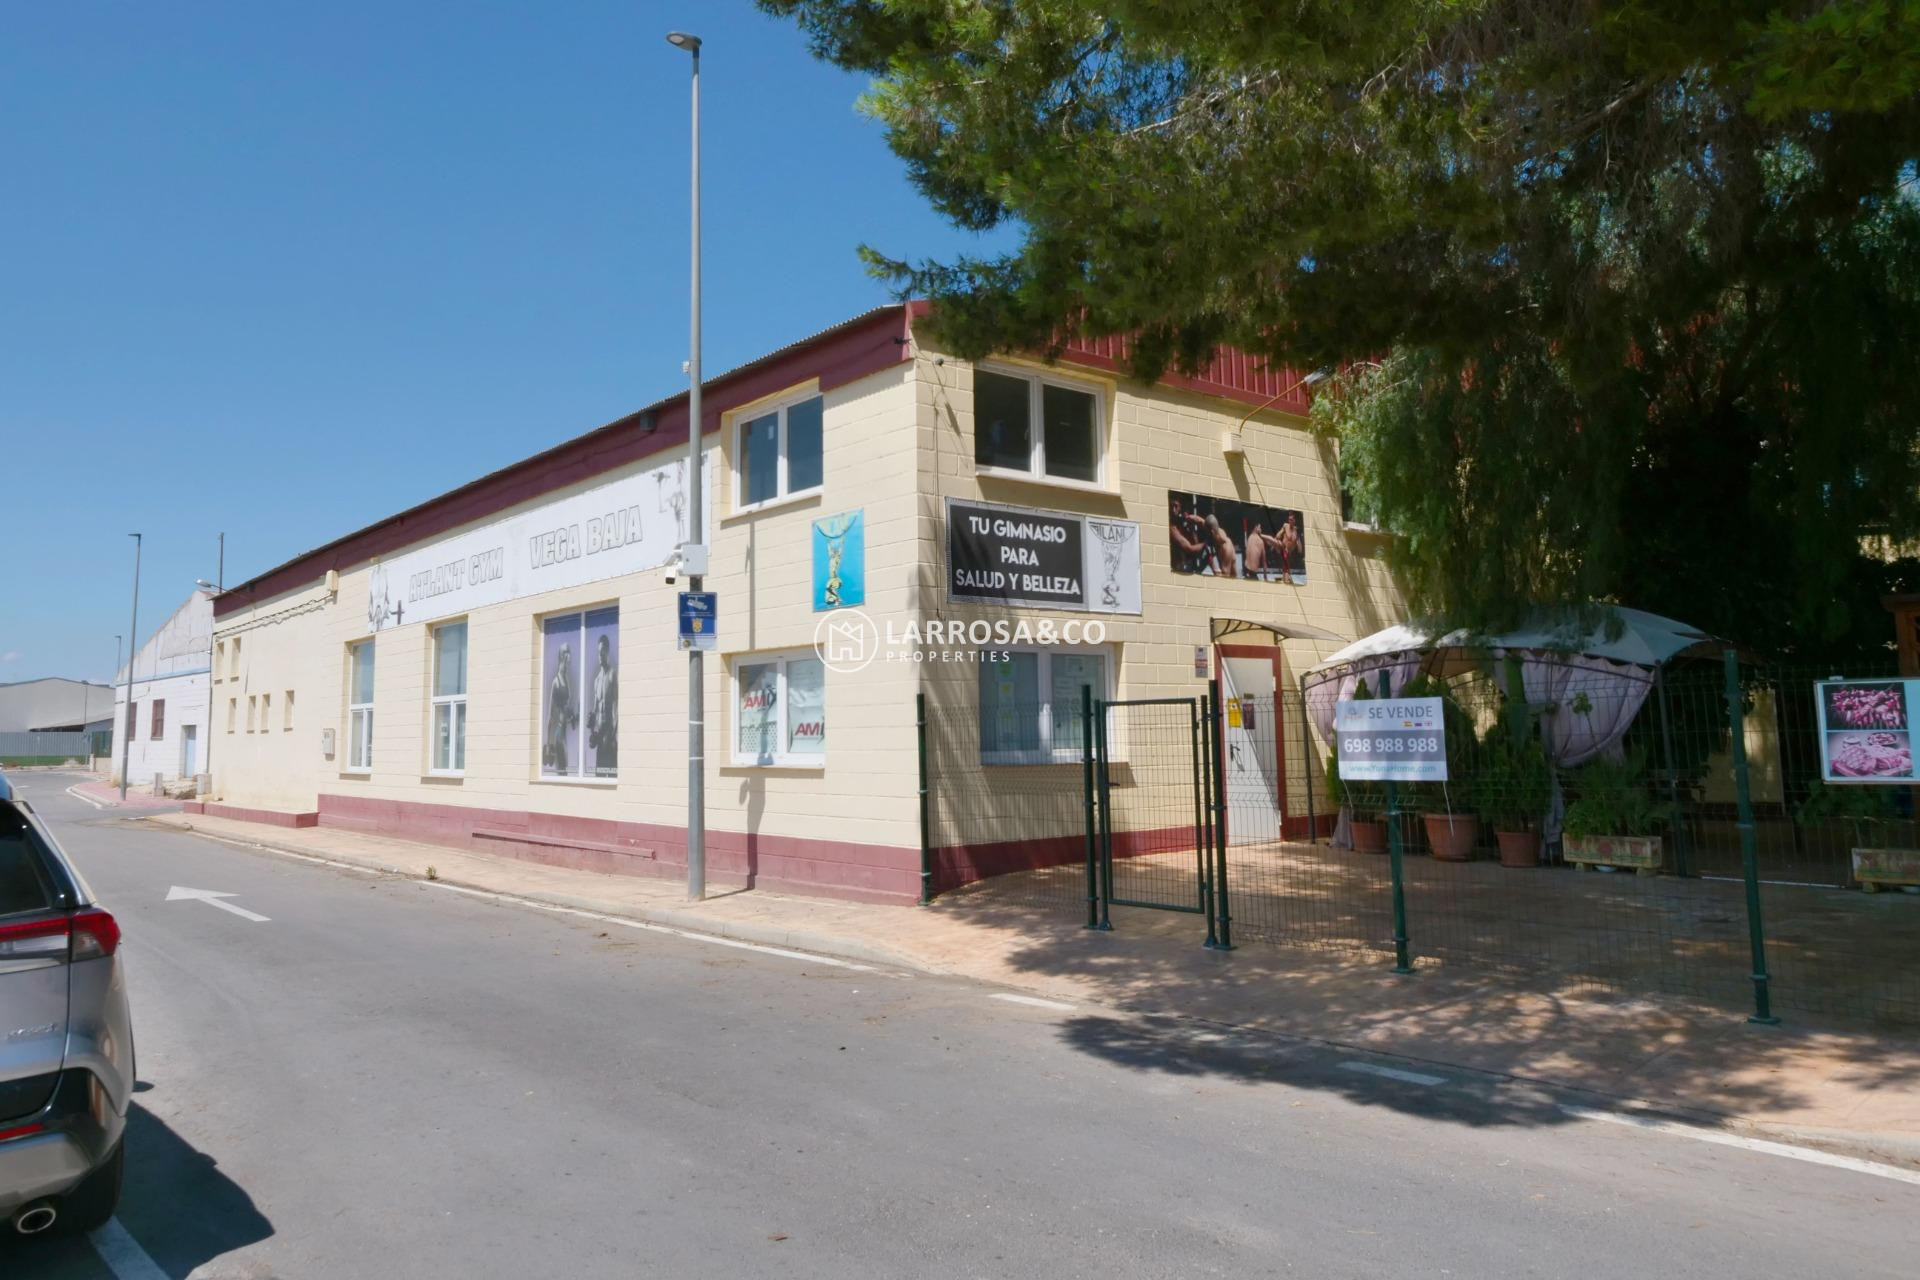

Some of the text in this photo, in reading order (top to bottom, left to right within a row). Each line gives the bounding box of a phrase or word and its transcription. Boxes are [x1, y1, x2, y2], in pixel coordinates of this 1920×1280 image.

[969, 516, 1067, 543] TU GIMNASIO
[408, 504, 643, 602] ATLANT GYM VEGA BAJA
[1000, 546, 1040, 566] PARA
[955, 568, 1081, 595] SALUD Y BELLEZA
[1368, 706, 1384, 719] SE
[1387, 705, 1433, 719] VENDE
[1344, 737, 1438, 753] 698 988 988
